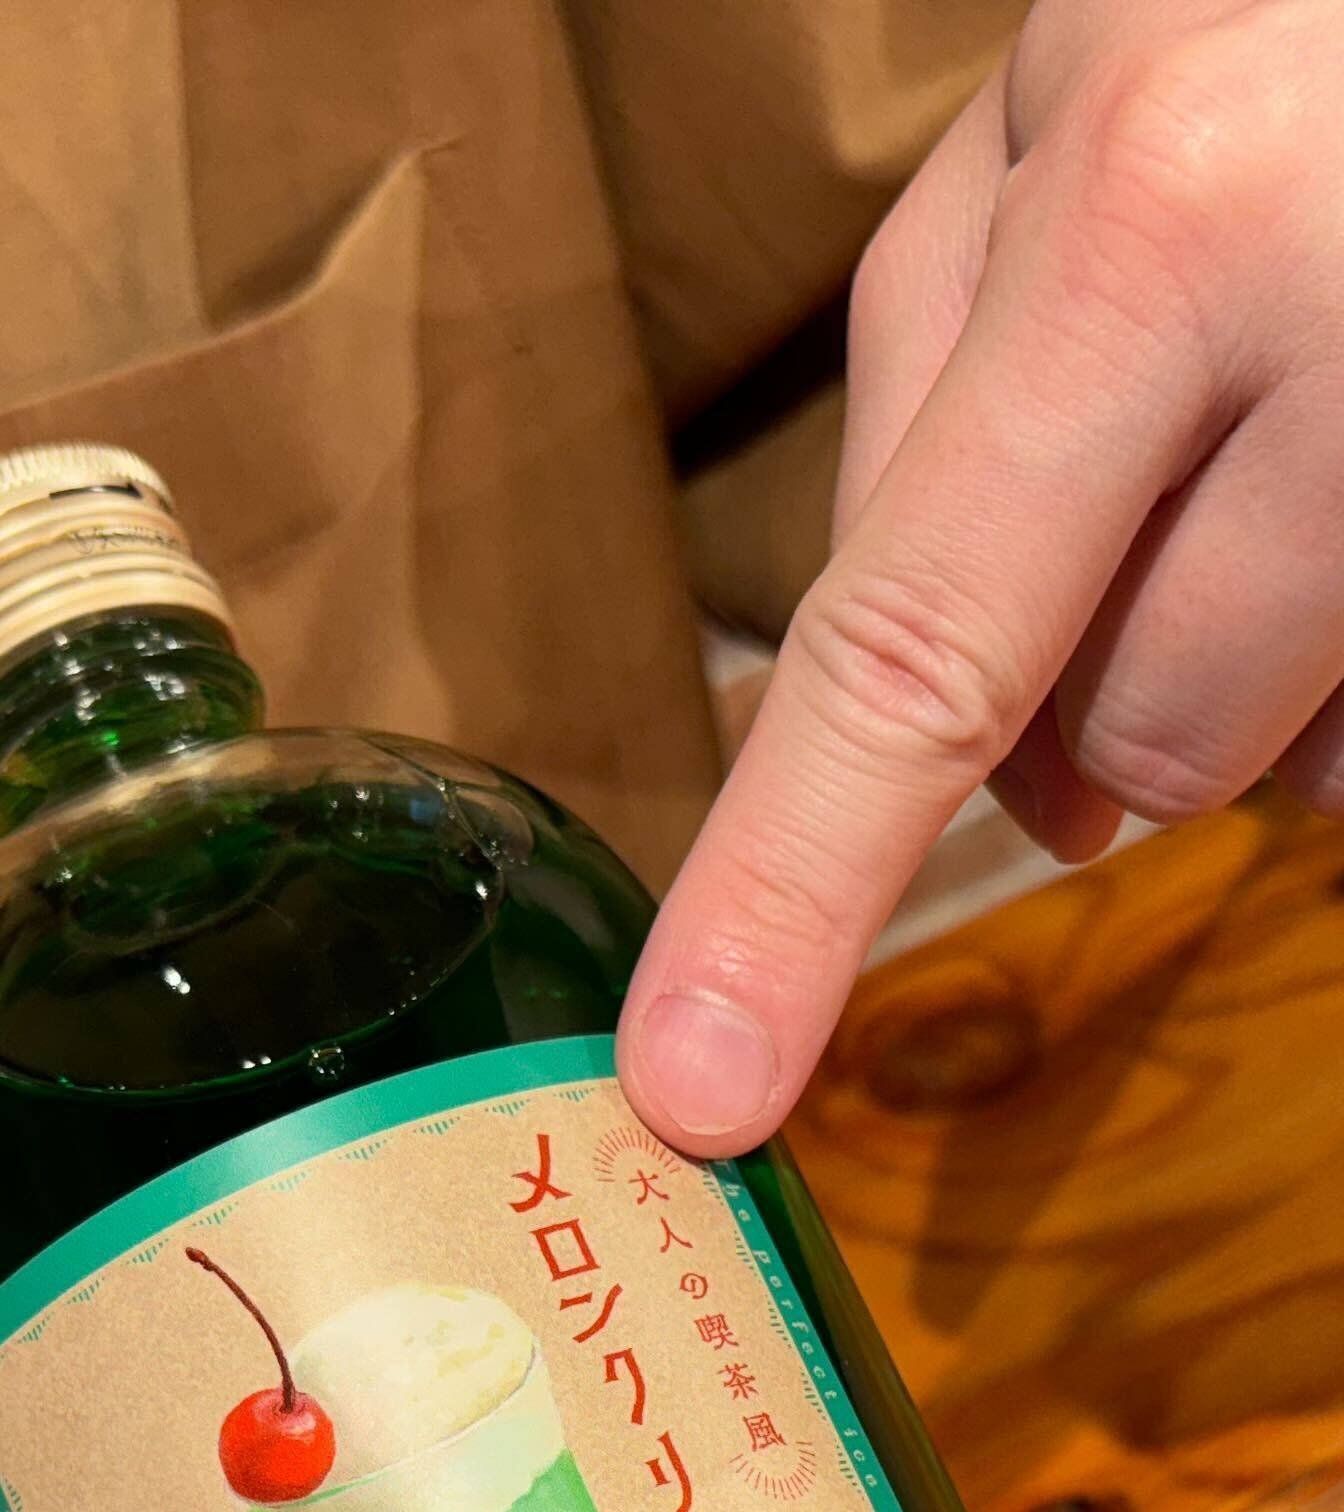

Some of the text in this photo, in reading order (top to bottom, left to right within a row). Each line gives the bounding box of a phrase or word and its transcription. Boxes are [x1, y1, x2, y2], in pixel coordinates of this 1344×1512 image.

[629, 1168, 787, 1451] 大人の喫茶風
[752, 1250, 837, 1401] perfect
[844, 1428, 878, 1488] ice
